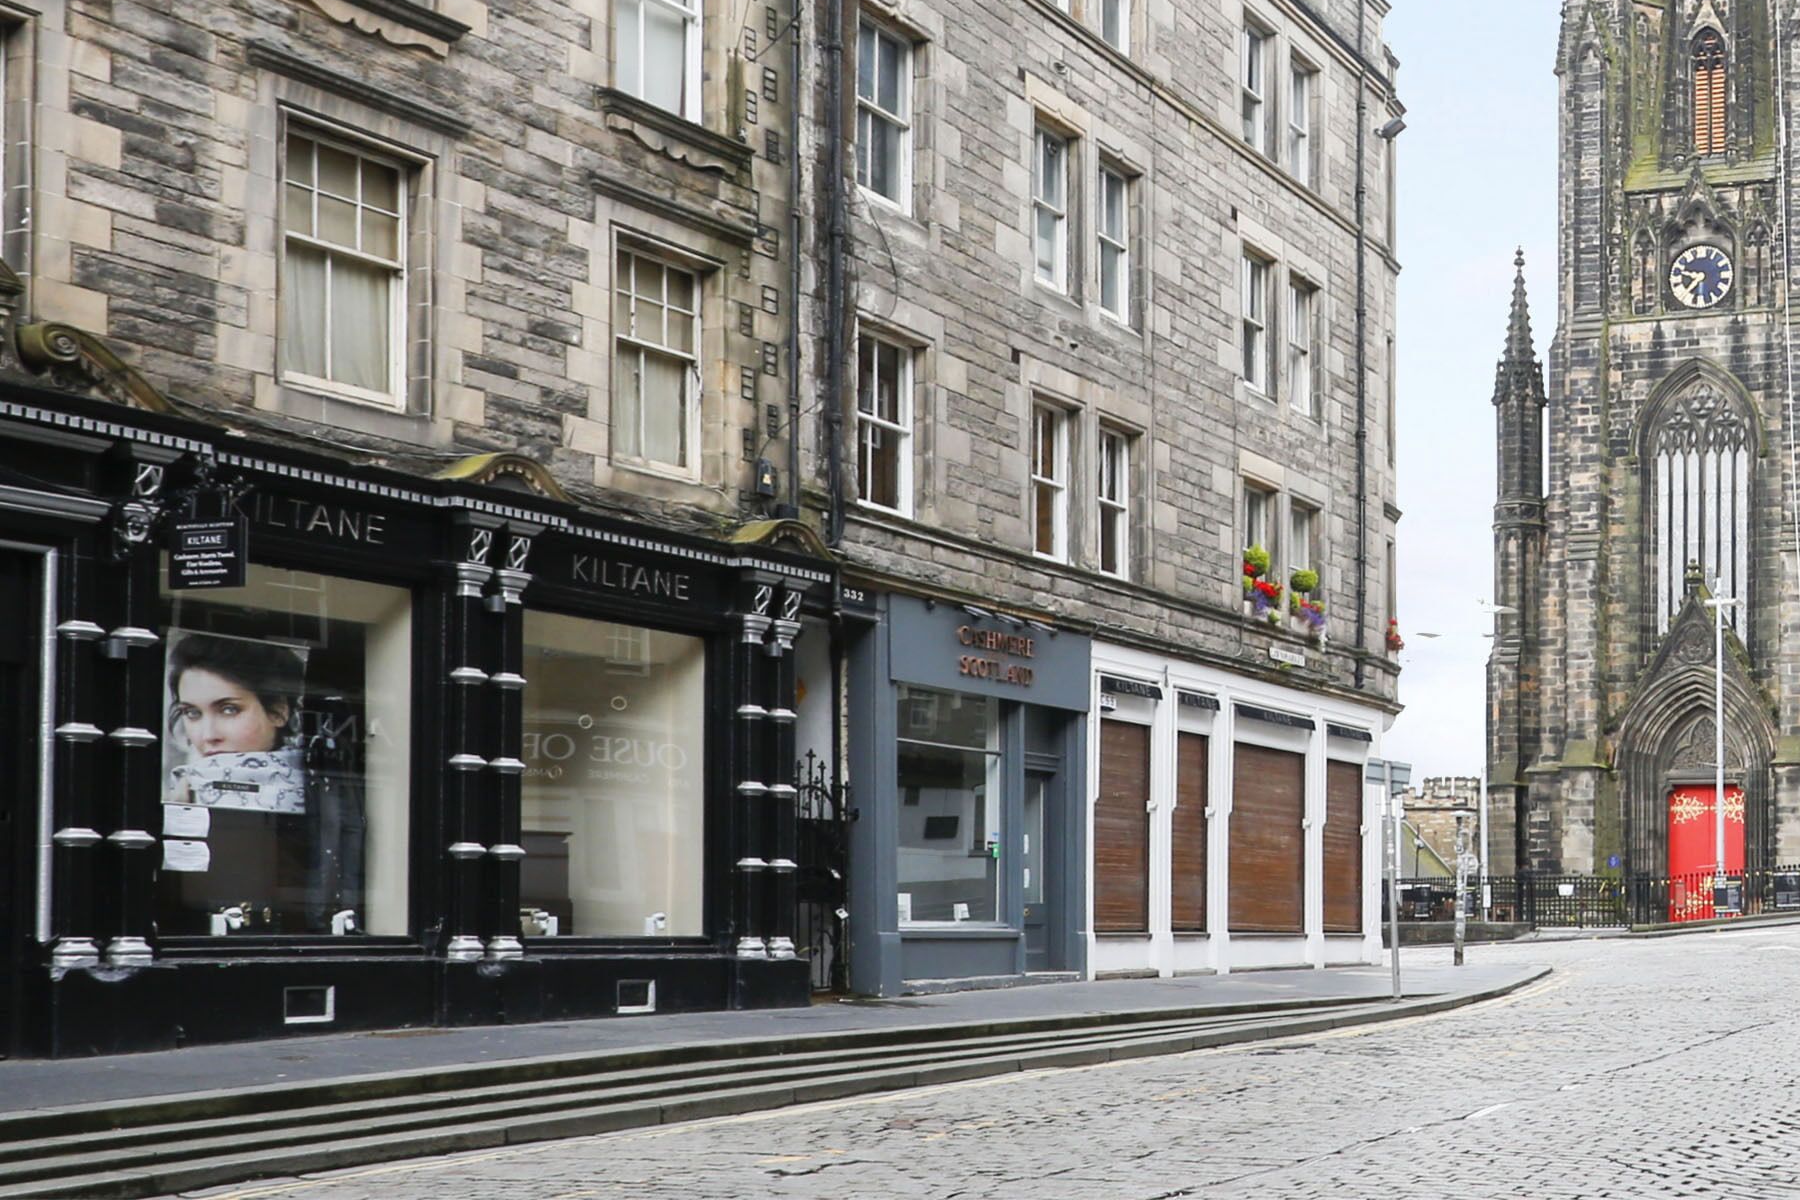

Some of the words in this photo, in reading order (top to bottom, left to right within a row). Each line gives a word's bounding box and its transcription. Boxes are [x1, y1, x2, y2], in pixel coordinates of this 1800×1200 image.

[228, 493, 386, 545] KILTANE
[187, 535, 222, 545] KILTANE
[572, 553, 690, 601] KILTANE
[843, 587, 865, 601] 332
[956, 655, 1033, 688] SCOTLAND
[1115, 681, 1152, 697] KILTANE
